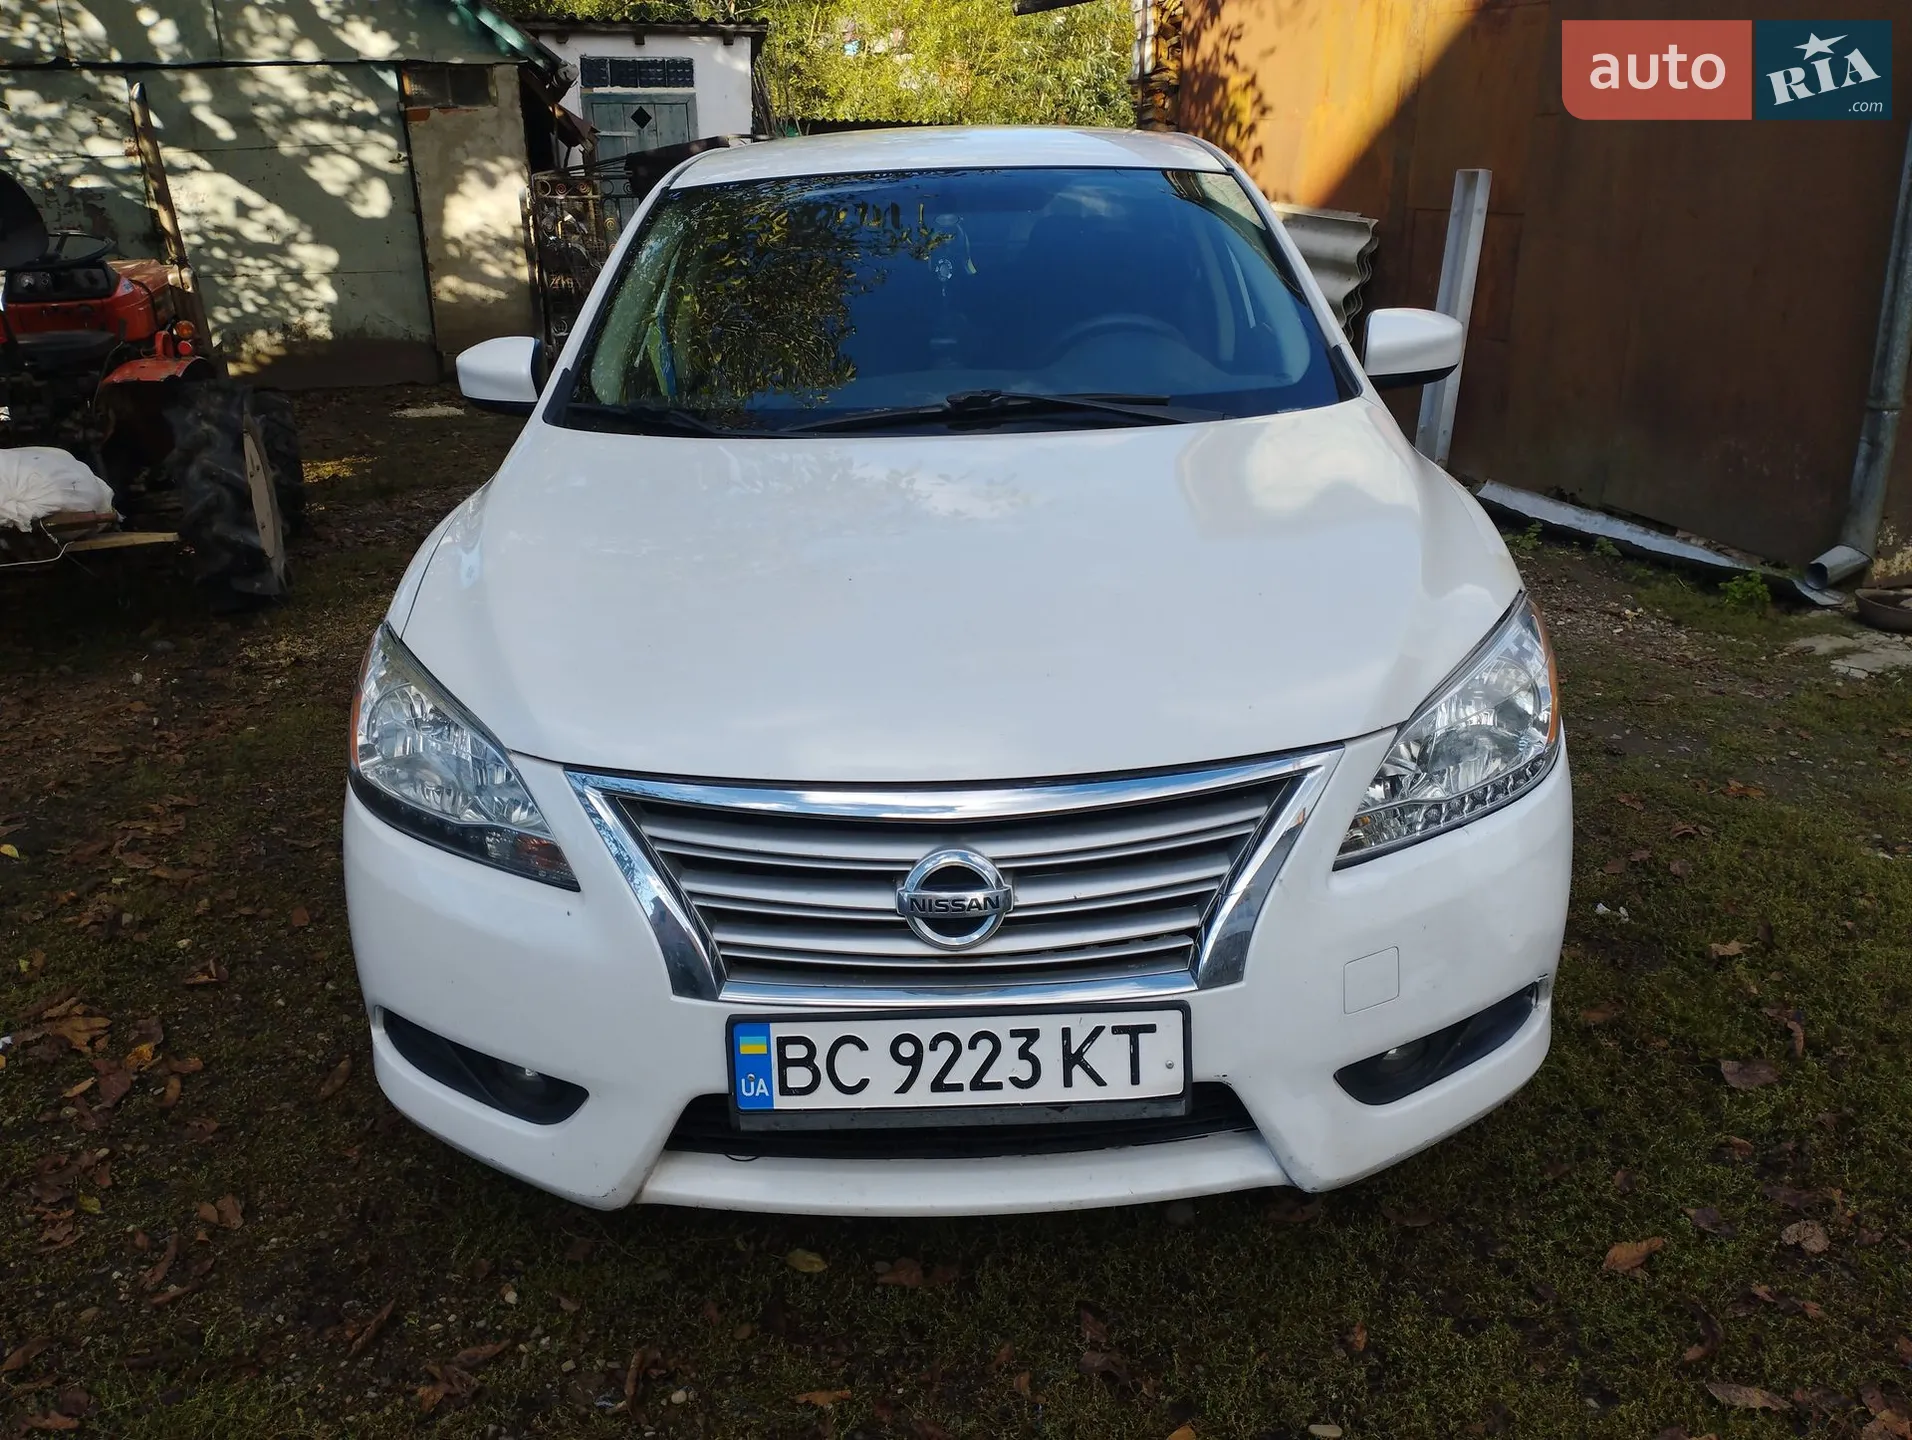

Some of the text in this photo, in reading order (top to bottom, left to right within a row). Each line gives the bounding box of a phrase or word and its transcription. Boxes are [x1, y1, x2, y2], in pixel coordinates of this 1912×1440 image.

[909, 895, 1000, 914] NISSAN
[776, 1023, 1158, 1097] BC 9223 KT
[741, 1078, 769, 1098] UA
